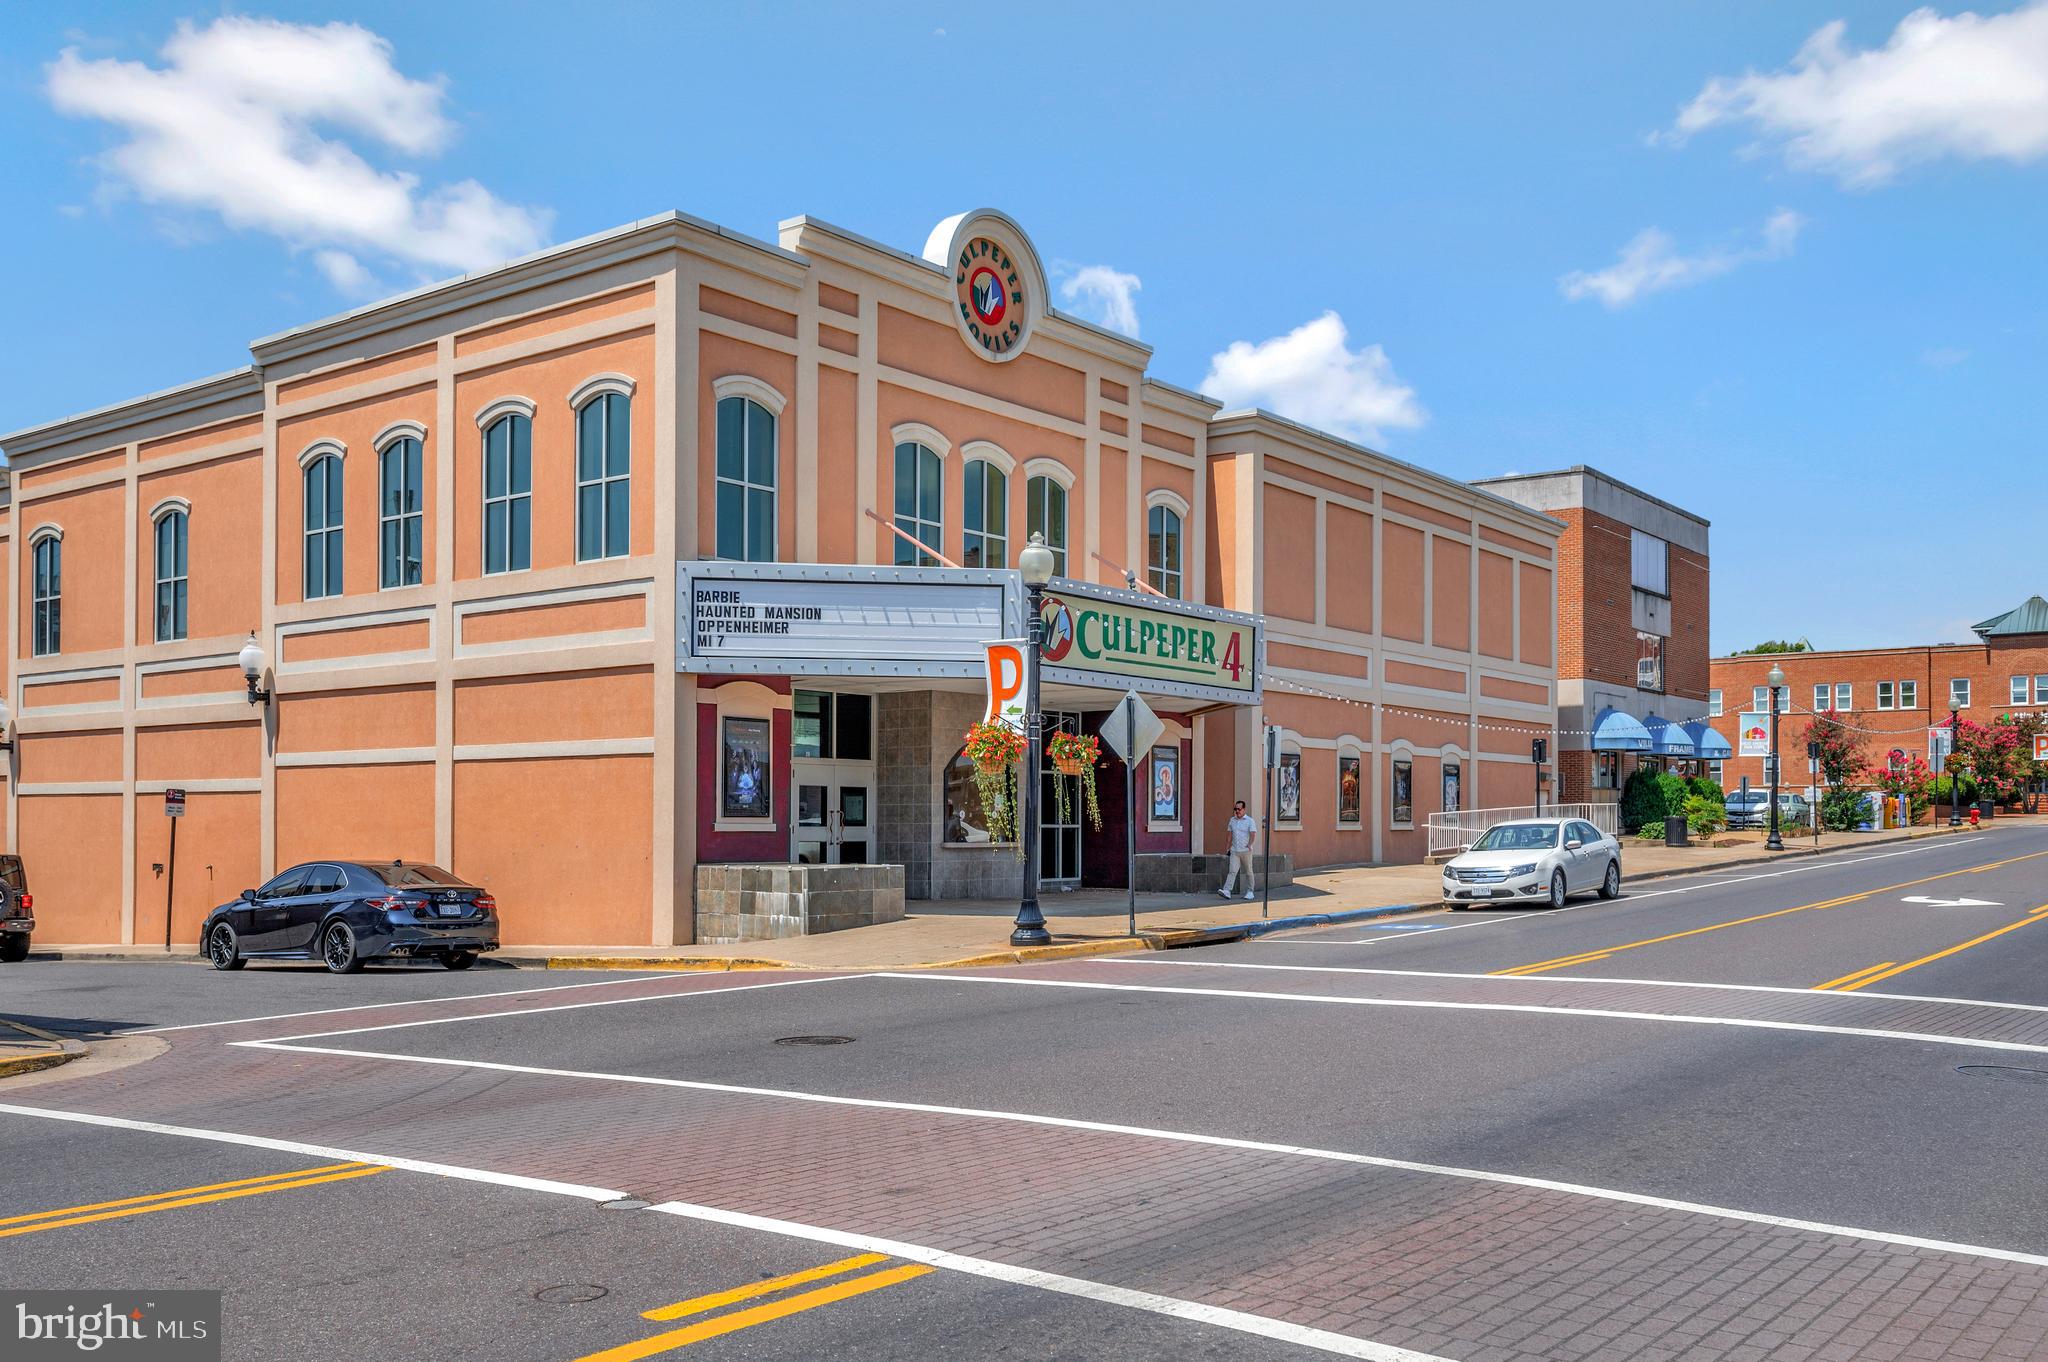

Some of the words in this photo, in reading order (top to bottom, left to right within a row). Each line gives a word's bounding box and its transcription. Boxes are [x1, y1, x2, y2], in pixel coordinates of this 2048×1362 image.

[957, 241, 1022, 305] CULPEPER
[960, 302, 1020, 351] MOVIES
[696, 590, 740, 603] BARBIE
[696, 605, 755, 619] HAUNTED
[764, 606, 821, 620] MANSION
[697, 635, 712, 647] MI
[717, 635, 725, 647] 7
[698, 620, 789, 634] OPPENHEIMER
[1076, 610, 1216, 665] CULPEPER
[1221, 631, 1245, 683] 4
[987, 645, 1023, 728] P
